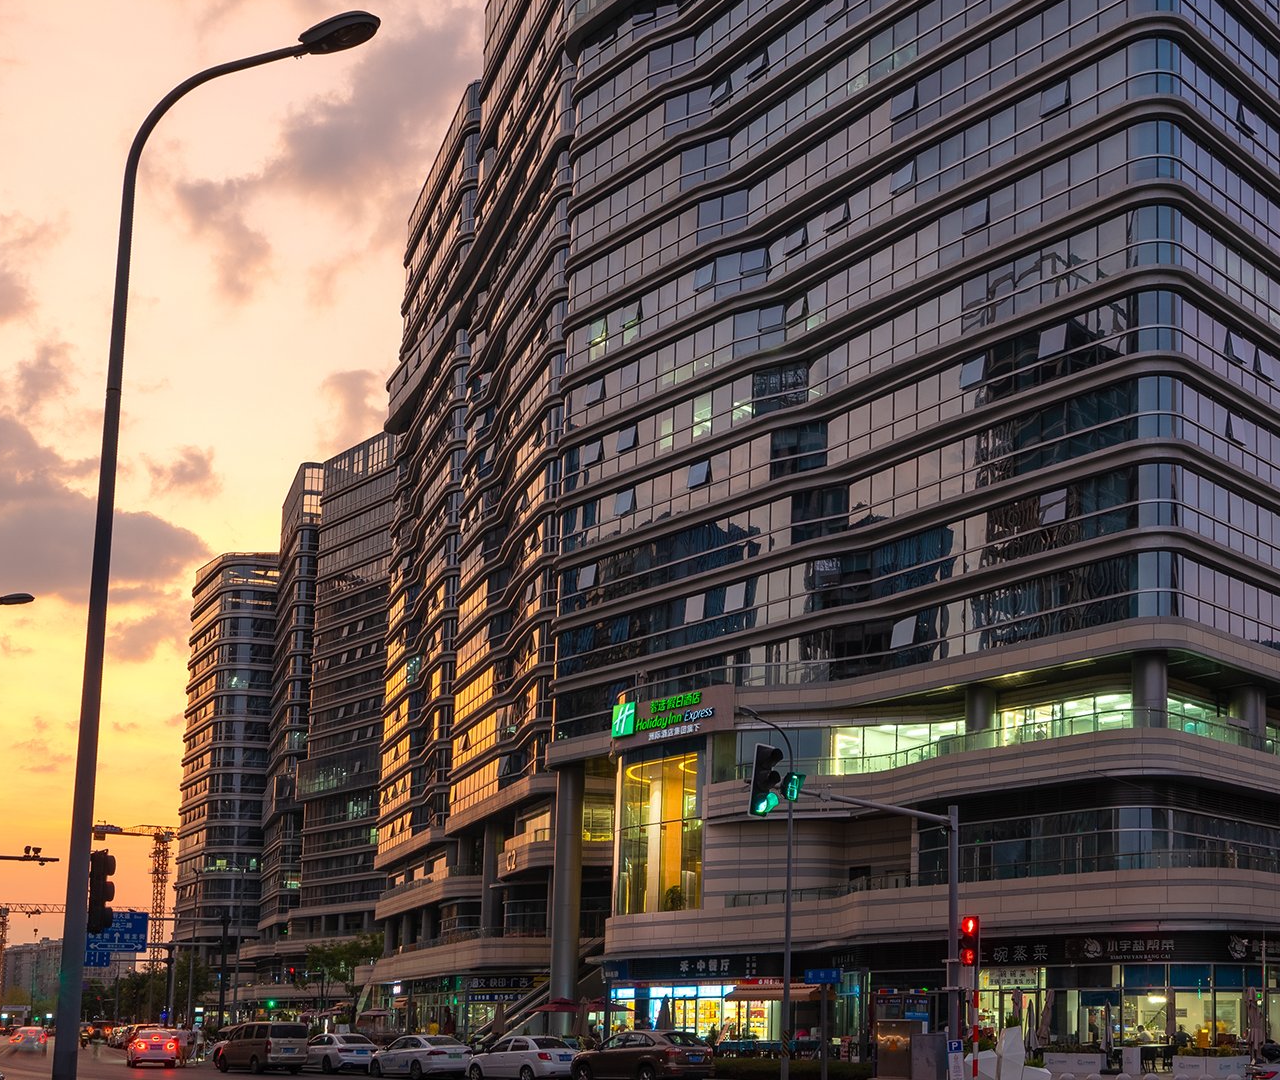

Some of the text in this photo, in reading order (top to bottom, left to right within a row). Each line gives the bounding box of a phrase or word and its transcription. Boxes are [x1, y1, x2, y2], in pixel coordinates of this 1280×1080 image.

[635, 707, 714, 732] Holiday Inn Express
[506, 849, 516, 872] C2
[951, 1042, 959, 1050] P
